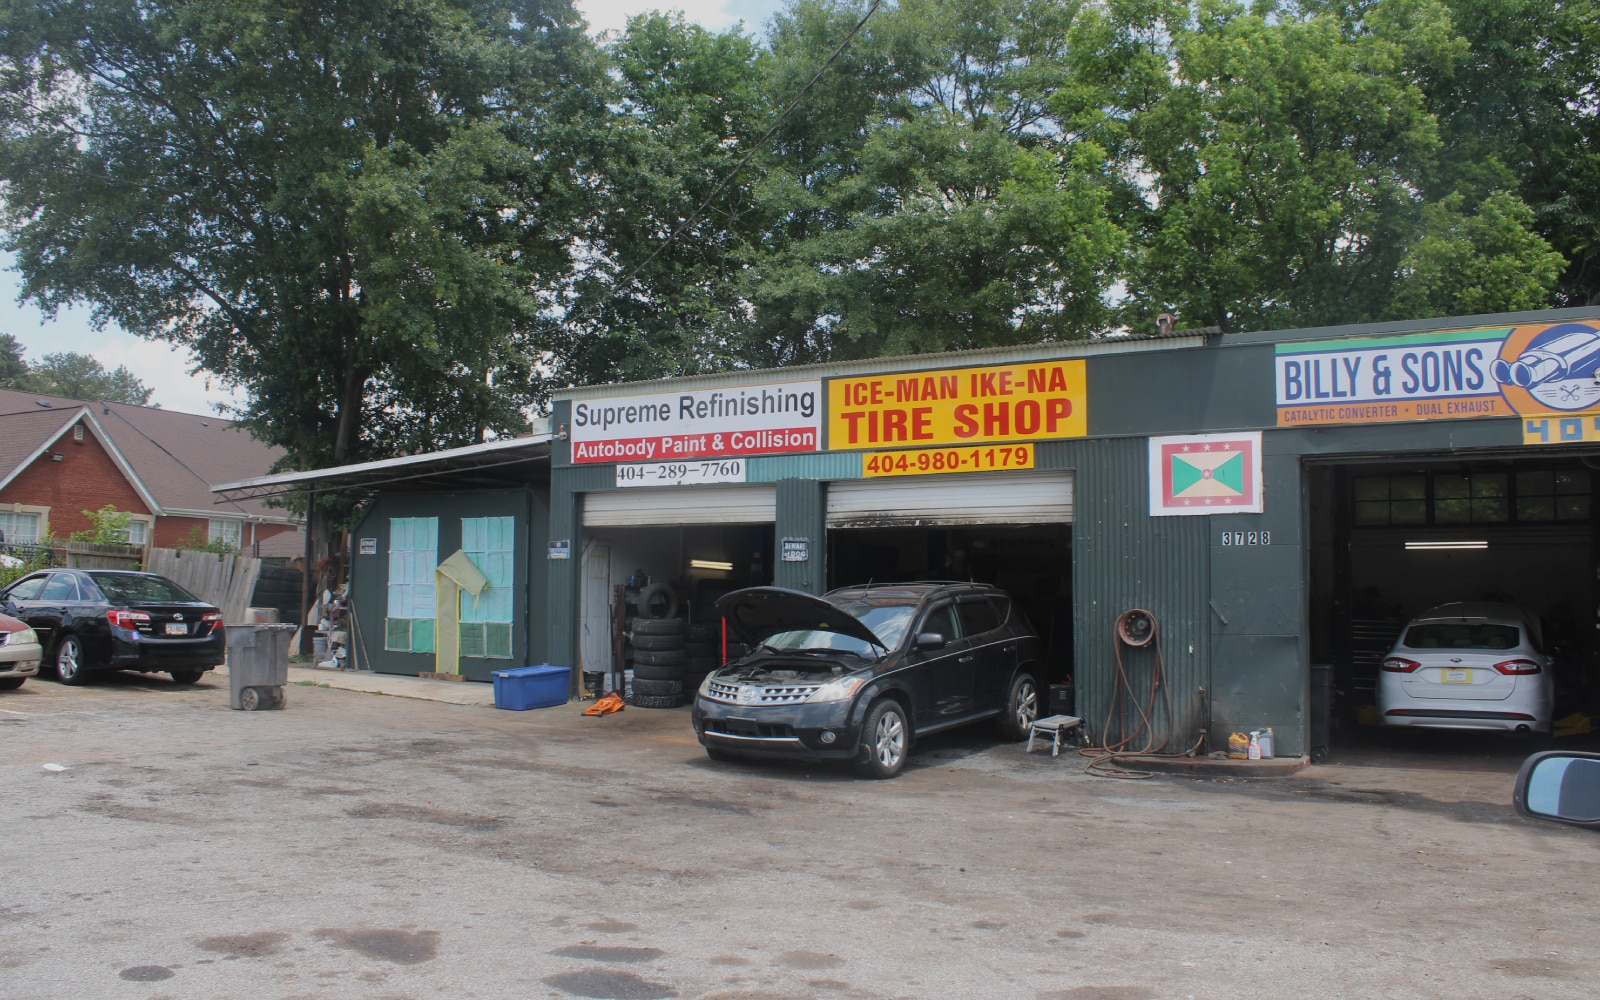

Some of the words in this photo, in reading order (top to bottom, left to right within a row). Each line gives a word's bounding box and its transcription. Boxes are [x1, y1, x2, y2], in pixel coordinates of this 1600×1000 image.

[844, 375, 958, 406] ICE-MAN
[971, 367, 1068, 398] IKE-NA
[1284, 356, 1361, 401] BILLY
[1372, 354, 1392, 395] &
[1401, 348, 1484, 394] SONS
[575, 403, 671, 431] Supreme
[679, 388, 815, 418] Refinishing
[841, 406, 933, 444] TIRE
[953, 398, 1072, 438] SHOP
[1284, 408, 1335, 422] CATALYTIC
[1339, 405, 1398, 419] CONVERTER
[1416, 403, 1443, 415] DUAL
[1447, 400, 1496, 414] EXHAUST
[576, 438, 656, 459] Autobody
[662, 433, 706, 454] Paint
[711, 434, 725, 451] &
[731, 430, 814, 450] Collision
[617, 461, 740, 481] 404-289-7760
[867, 446, 1028, 473] 404-980-1179
[1223, 532, 1270, 545] 3728
